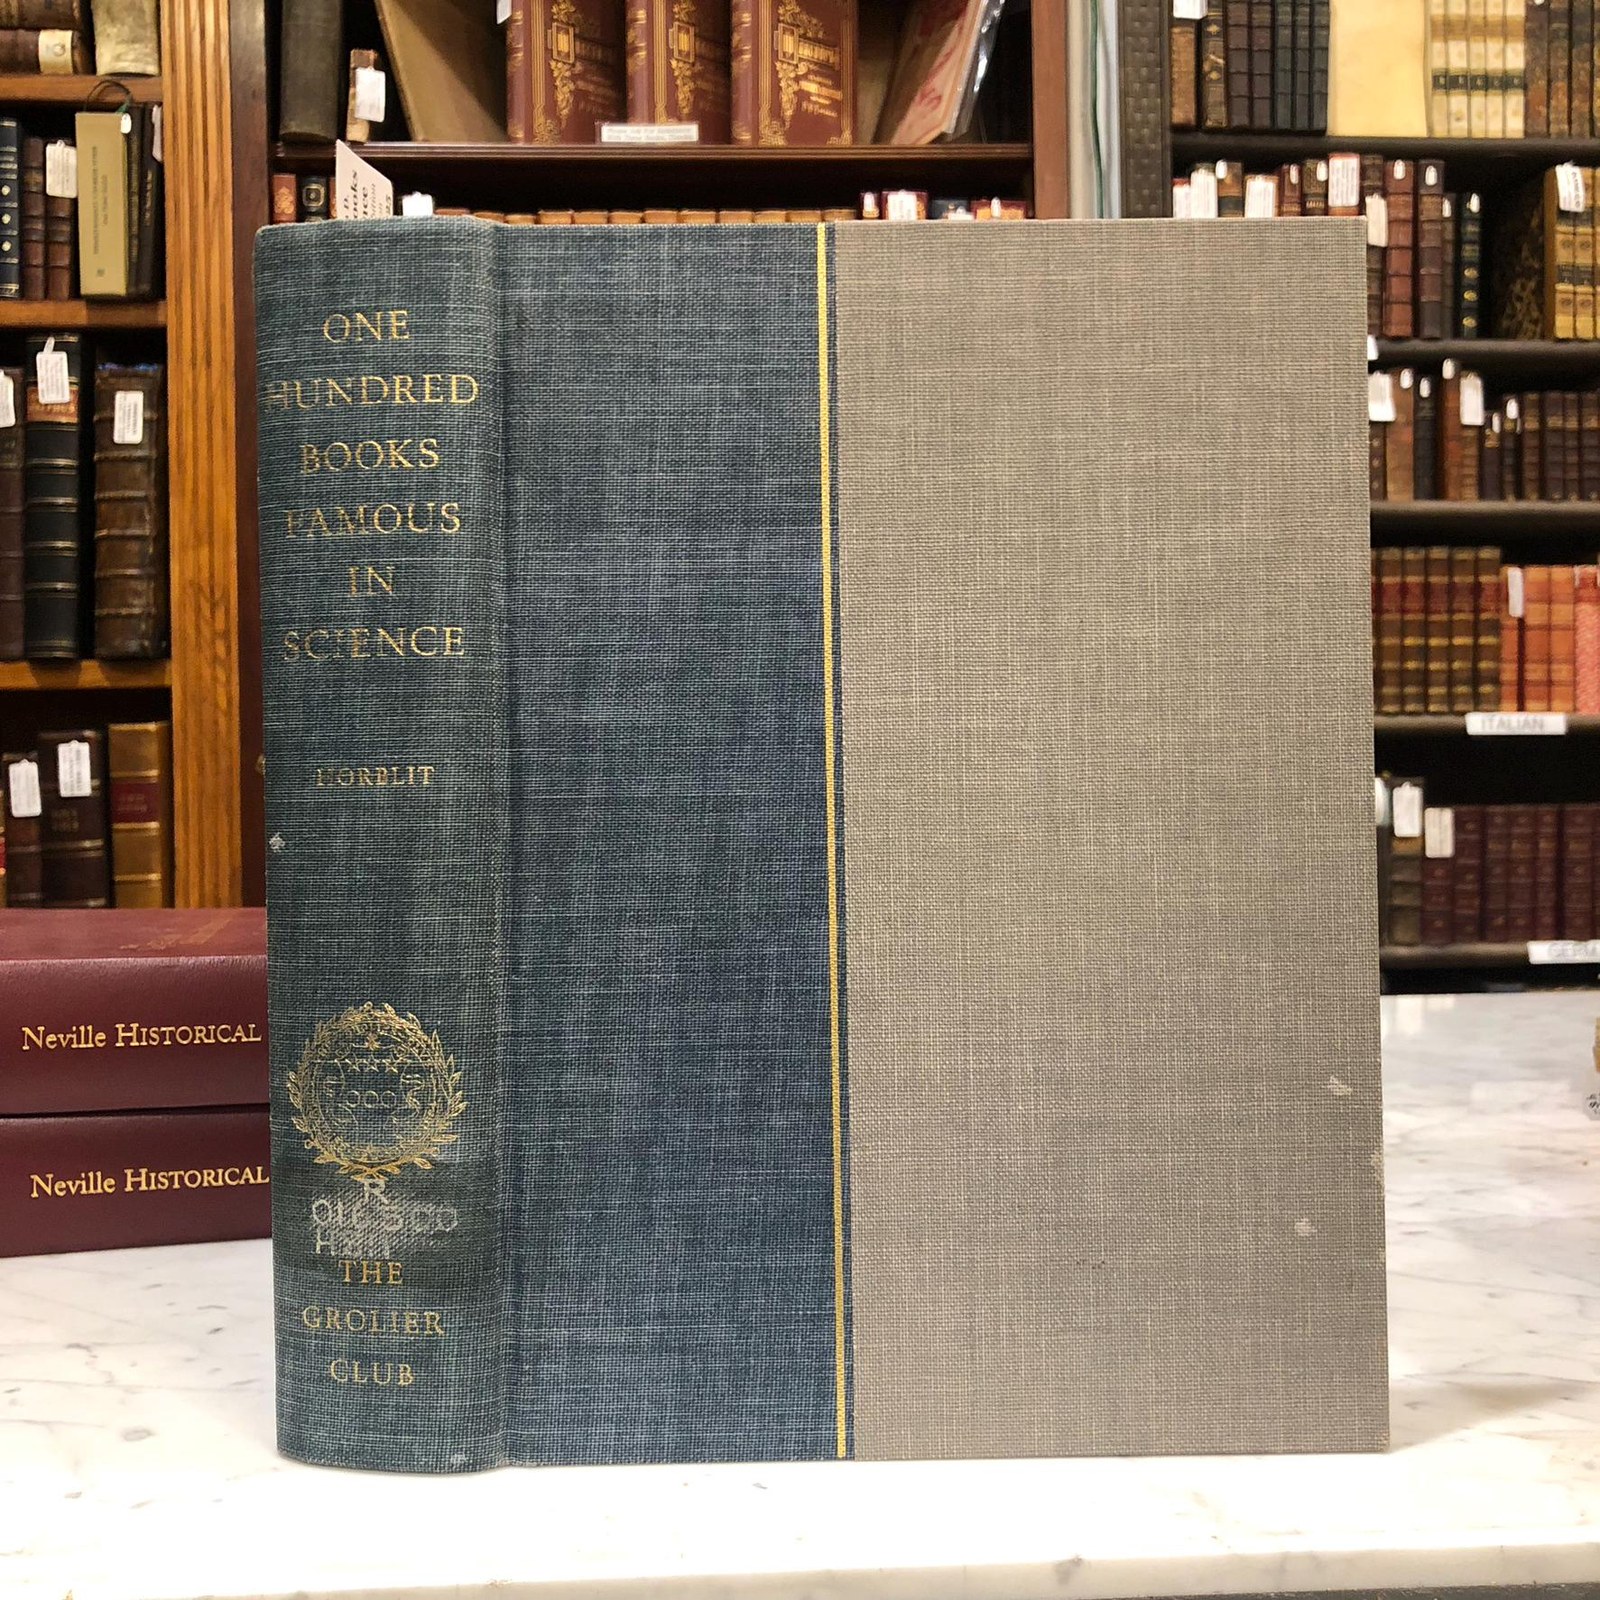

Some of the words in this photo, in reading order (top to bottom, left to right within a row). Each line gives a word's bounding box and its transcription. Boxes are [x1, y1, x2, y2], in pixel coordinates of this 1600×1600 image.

[322, 309, 411, 343] ONE
[264, 373, 480, 412] HUNDRED
[300, 438, 441, 475] BOOKS
[285, 502, 462, 539] FAMOUS
[348, 565, 396, 597] IN
[282, 625, 466, 661] SCIENCE
[1481, 714, 1546, 731] ITALIAN
[315, 766, 435, 786] HORBLIT
[22, 1025, 107, 1050] Neville
[115, 1023, 262, 1047] HISTORICAL
[30, 1171, 116, 1198] Neville
[124, 1166, 270, 1192] HISTORICAL
[338, 1259, 403, 1285] THE
[302, 1306, 446, 1337] GROLIER
[330, 1358, 415, 1386] CLUB
